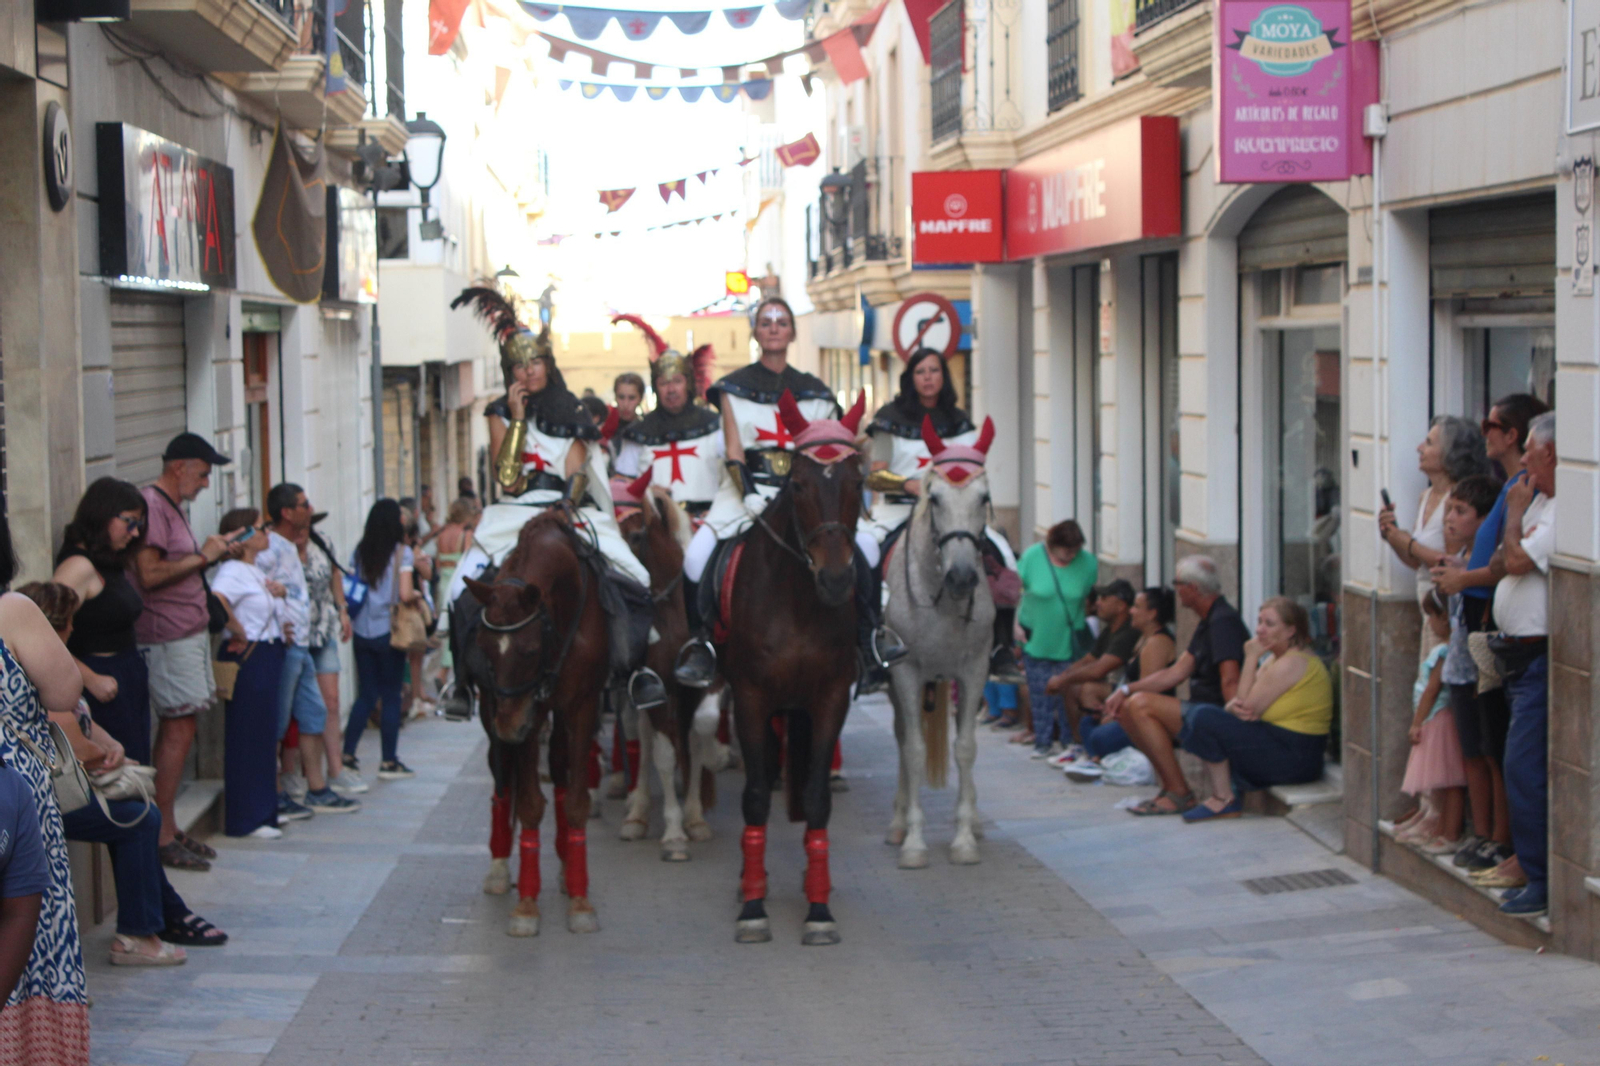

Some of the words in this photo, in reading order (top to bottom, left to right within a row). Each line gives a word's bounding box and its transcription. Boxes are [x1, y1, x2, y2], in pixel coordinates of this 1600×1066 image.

[1261, 23, 1313, 38] MOYA
[1253, 43, 1319, 58] VARIEDADES
[1580, 26, 1600, 101] E
[1287, 106, 1299, 120] DE
[1302, 105, 1339, 120] REGALO
[1234, 136, 1339, 154] MULTIPRECIO
[1042, 158, 1106, 231] MAPFRE
[146, 150, 224, 274] ATLANTA
[920, 218, 992, 234] MAPFRE
